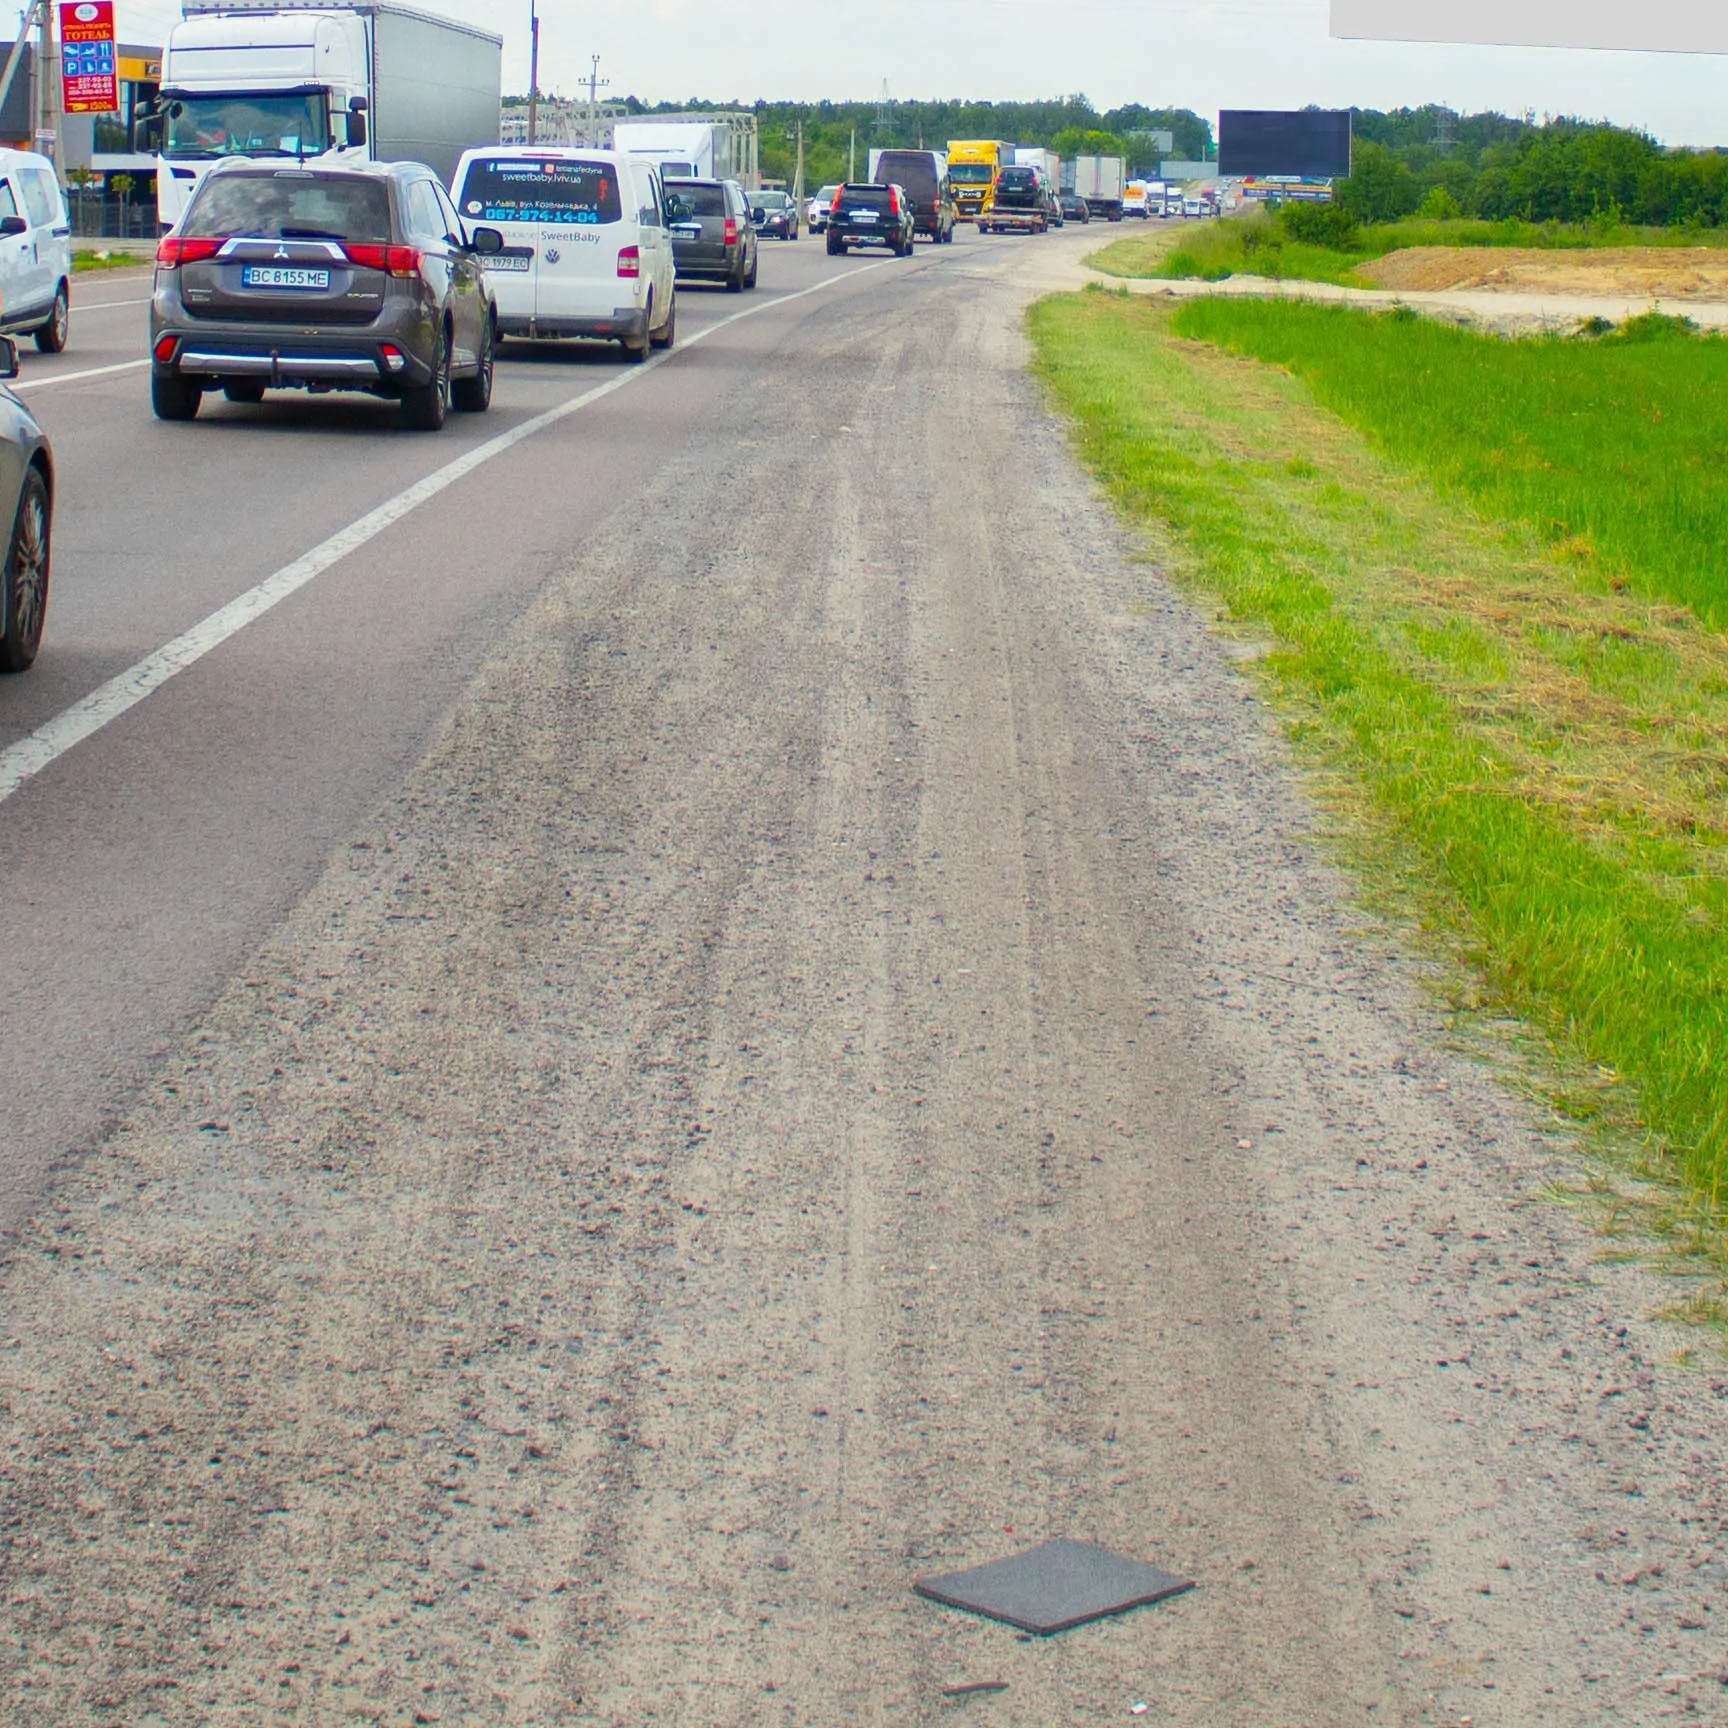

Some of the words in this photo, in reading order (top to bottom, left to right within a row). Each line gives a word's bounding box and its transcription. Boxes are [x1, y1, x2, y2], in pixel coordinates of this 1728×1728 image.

[65, 29, 111, 41] ГОТЕЛЬ
[502, 172, 582, 184] sweetbaby.lviv.ua
[485, 208, 598, 224] 067-974-14-04
[541, 231, 601, 244] SweetBaby
[492, 257, 513, 268] 1979
[251, 269, 271, 283] BC
[273, 270, 305, 285] 8155
[307, 272, 327, 286] ME
